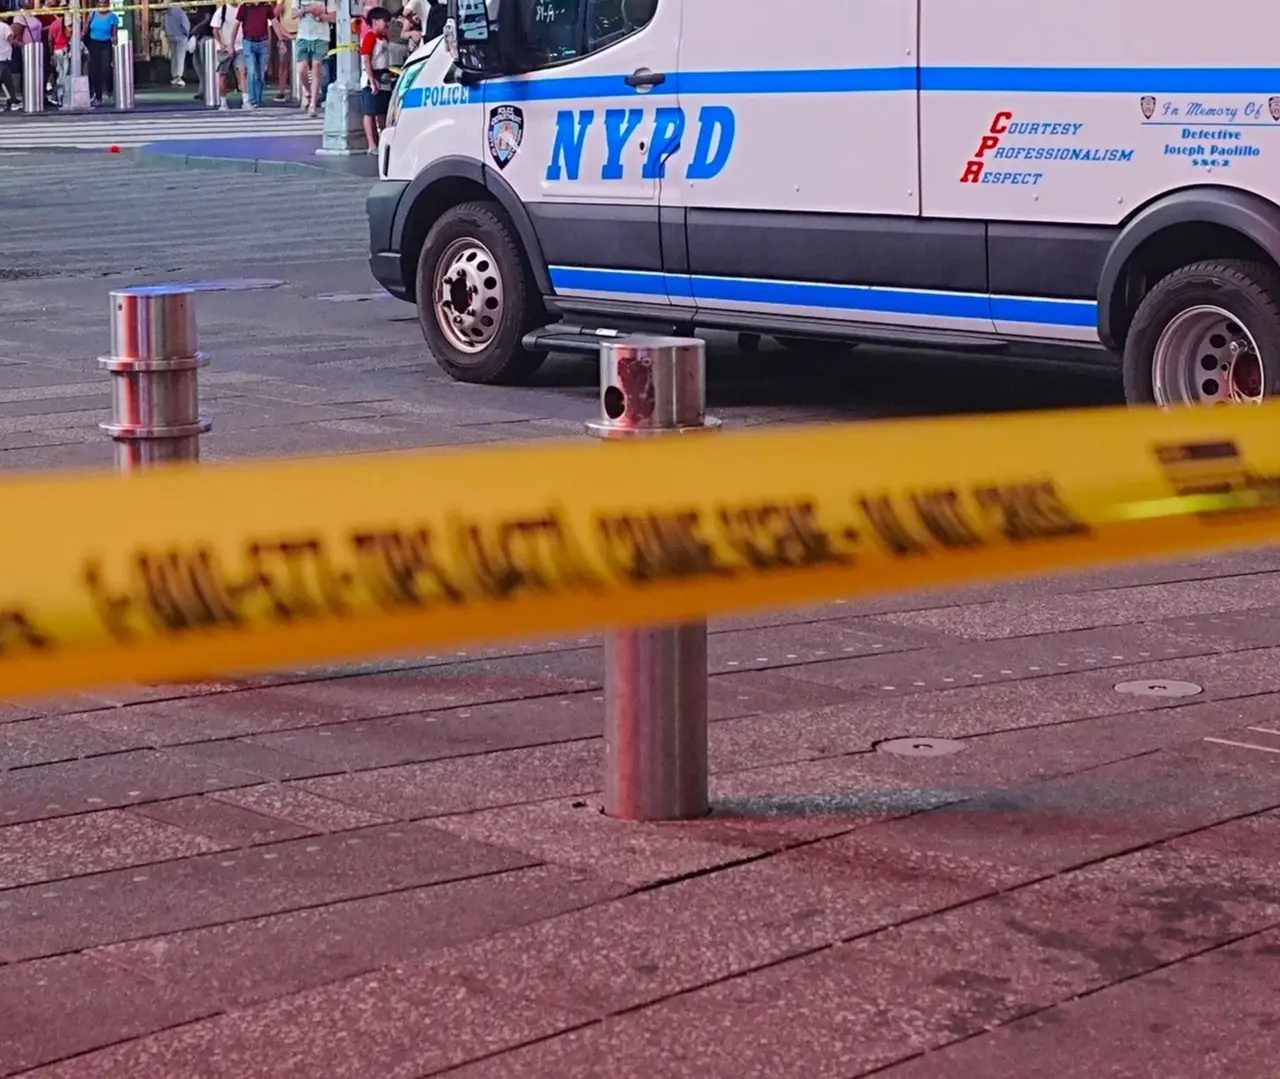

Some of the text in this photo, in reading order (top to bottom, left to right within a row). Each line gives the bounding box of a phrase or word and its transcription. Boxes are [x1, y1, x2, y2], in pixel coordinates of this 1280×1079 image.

[424, 87, 469, 107] POLICE
[1161, 101, 1264, 122] In Memory Of
[990, 111, 1083, 135] COURTESY
[1181, 128, 1241, 140] Detective
[546, 106, 736, 180] NYPD
[975, 136, 1134, 161] PROFESSIONALISM
[1164, 144, 1260, 157] Joseph Paolillo
[960, 161, 1043, 185] RESPECT
